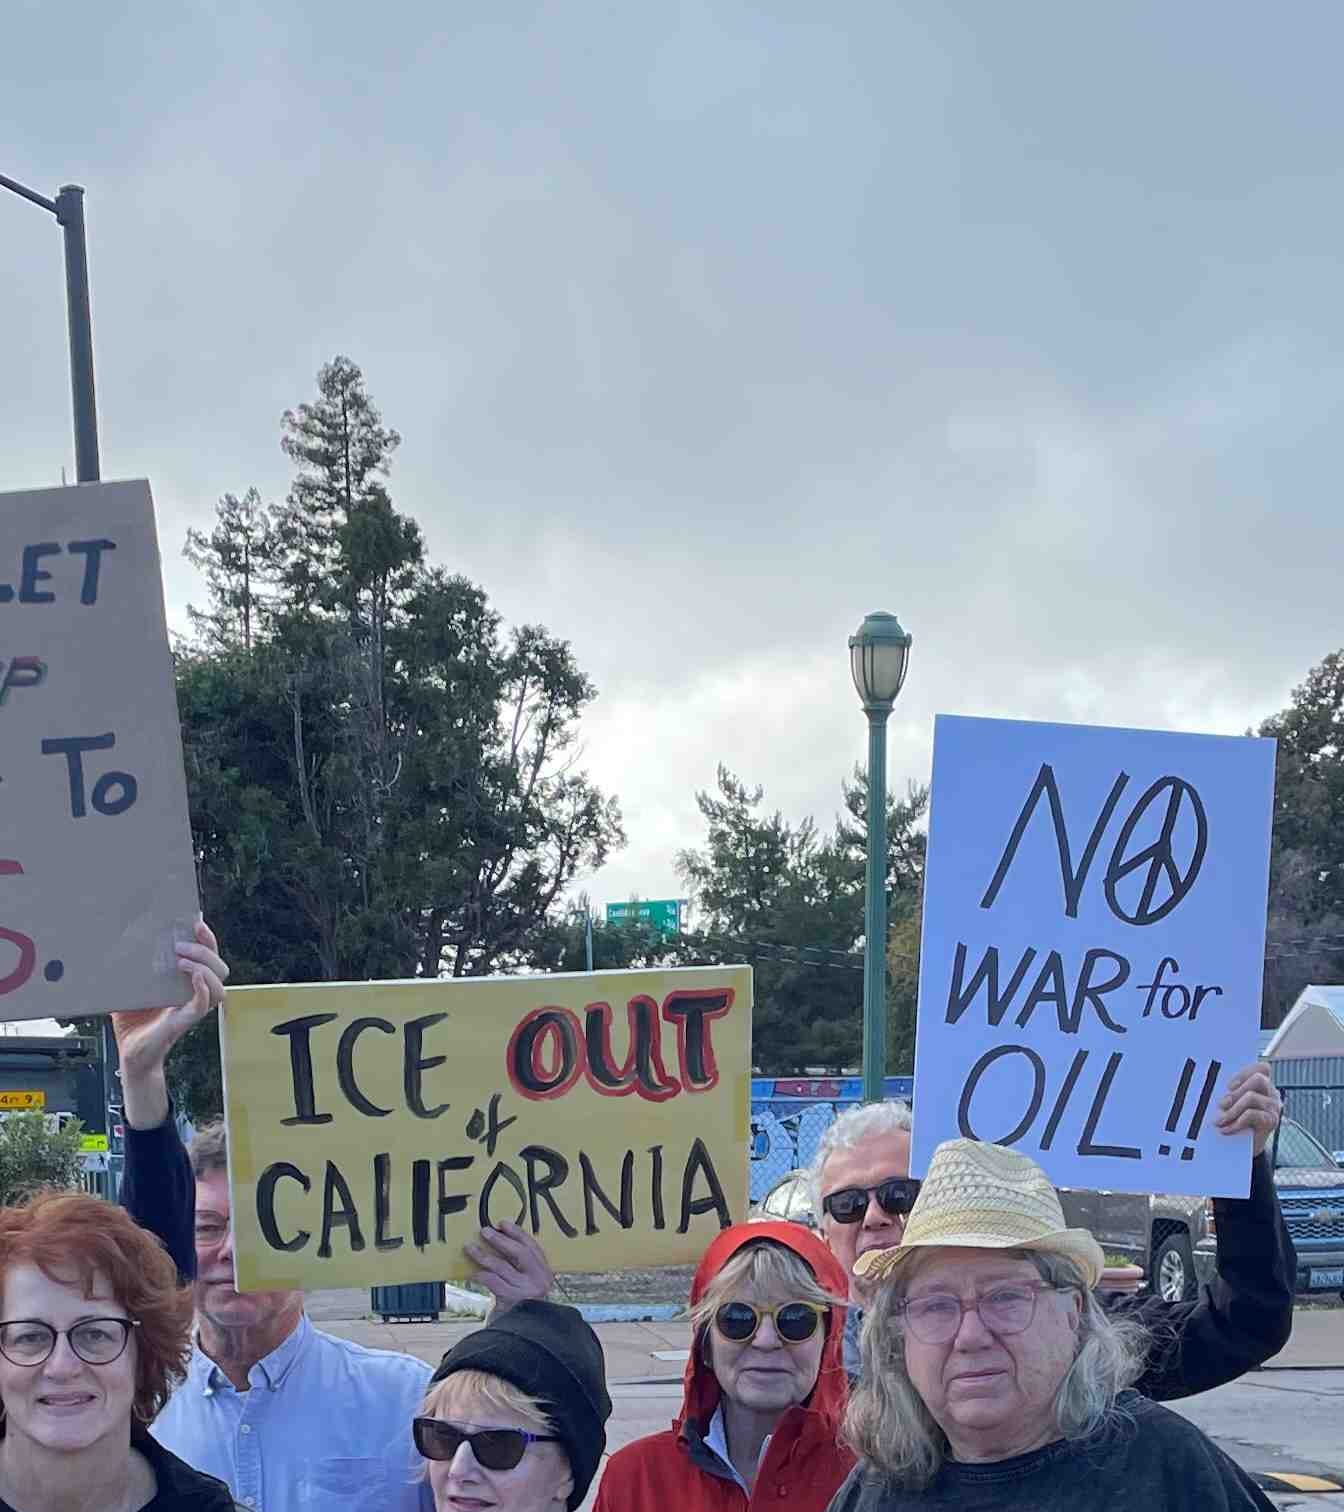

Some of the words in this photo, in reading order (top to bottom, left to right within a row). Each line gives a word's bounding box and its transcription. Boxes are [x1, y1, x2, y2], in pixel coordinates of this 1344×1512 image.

[979, 763, 1207, 926] NO
[945, 941, 1131, 1034] WAR
[1136, 956, 1223, 1021] for
[270, 1011, 451, 1126] ICE
[506, 986, 736, 1103] OUT
[465, 1092, 518, 1157] of
[256, 1137, 732, 1259] CALIFORNIA
